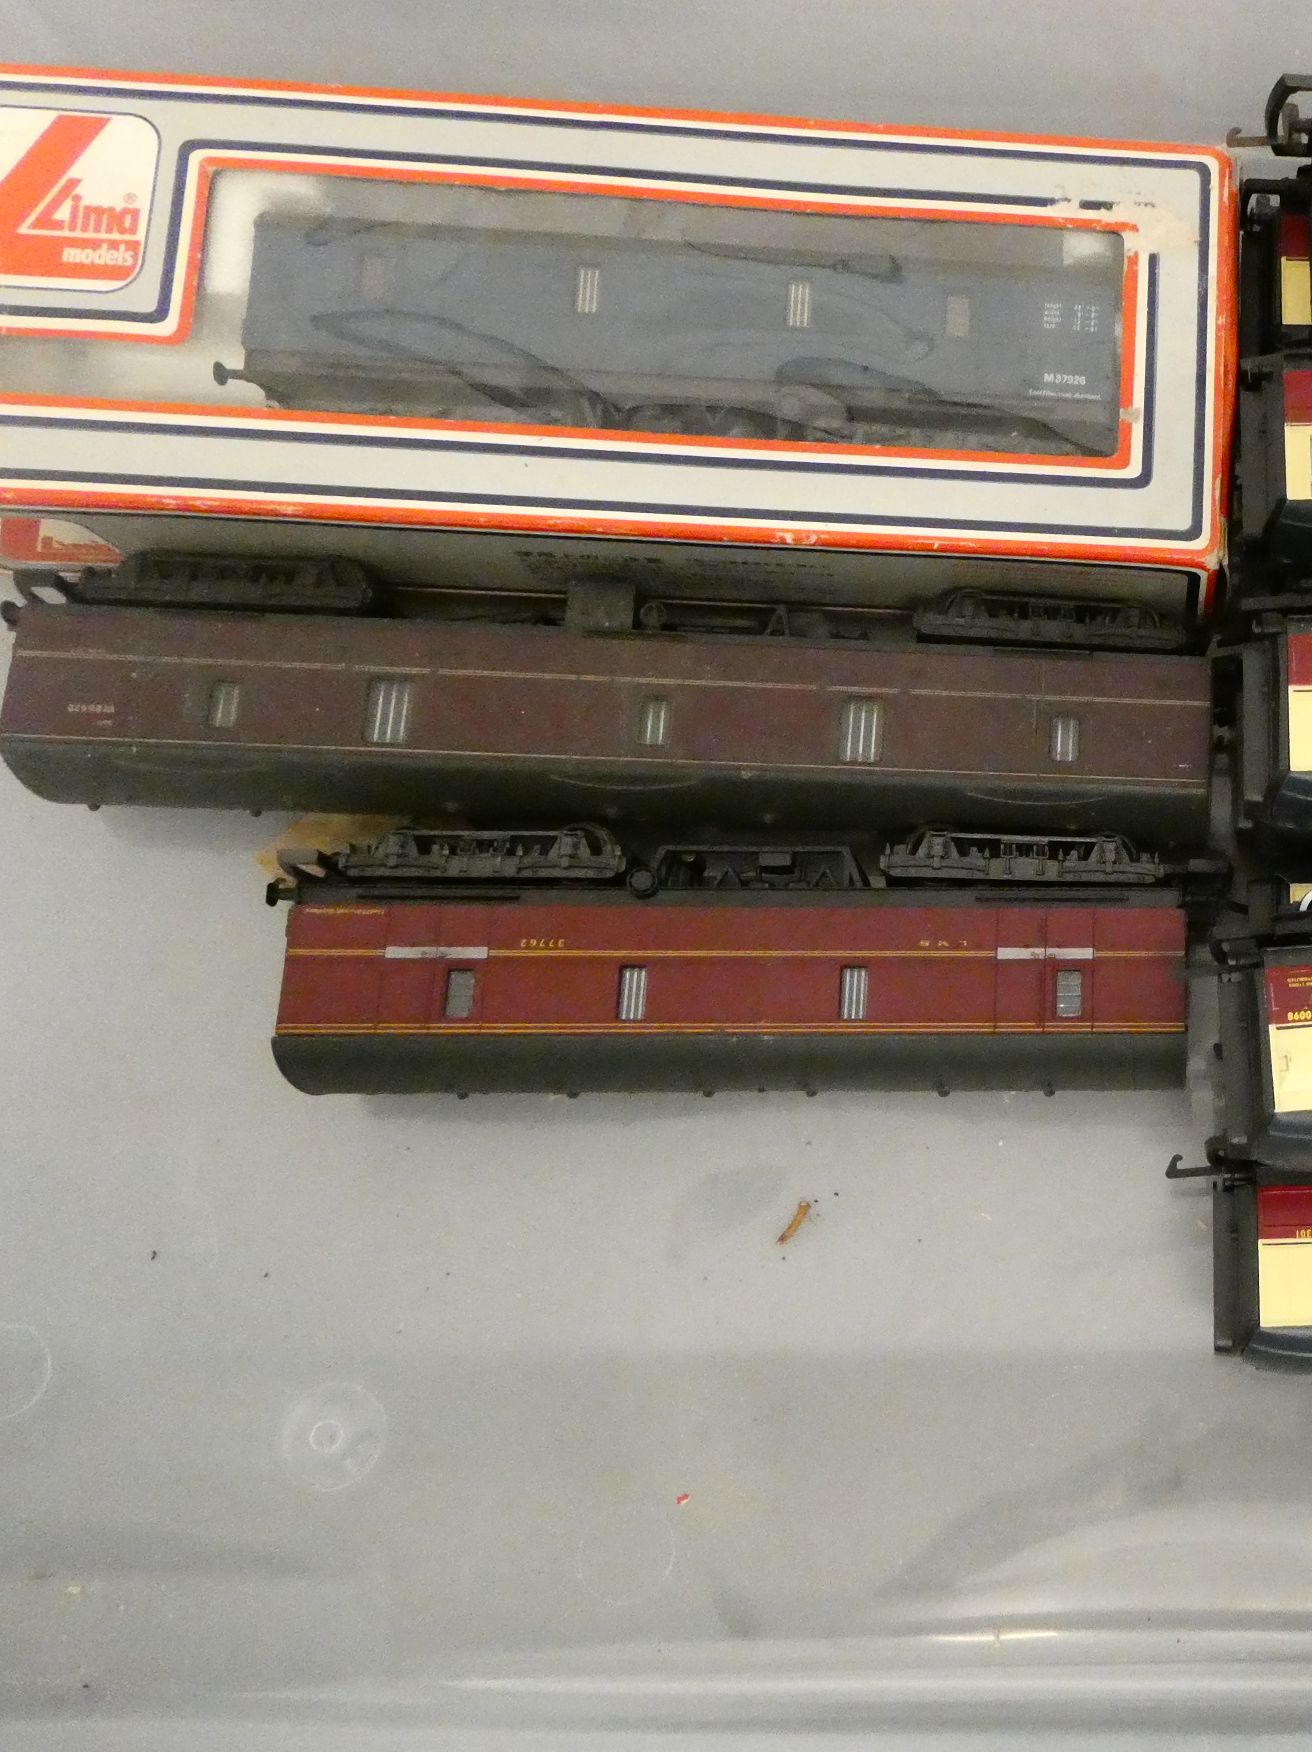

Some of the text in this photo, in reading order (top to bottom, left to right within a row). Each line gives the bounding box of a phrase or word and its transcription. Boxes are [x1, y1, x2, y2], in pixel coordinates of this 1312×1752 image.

[27, 177, 141, 236] Lima
[62, 243, 136, 266] models
[520, 938, 565, 948] 37762
